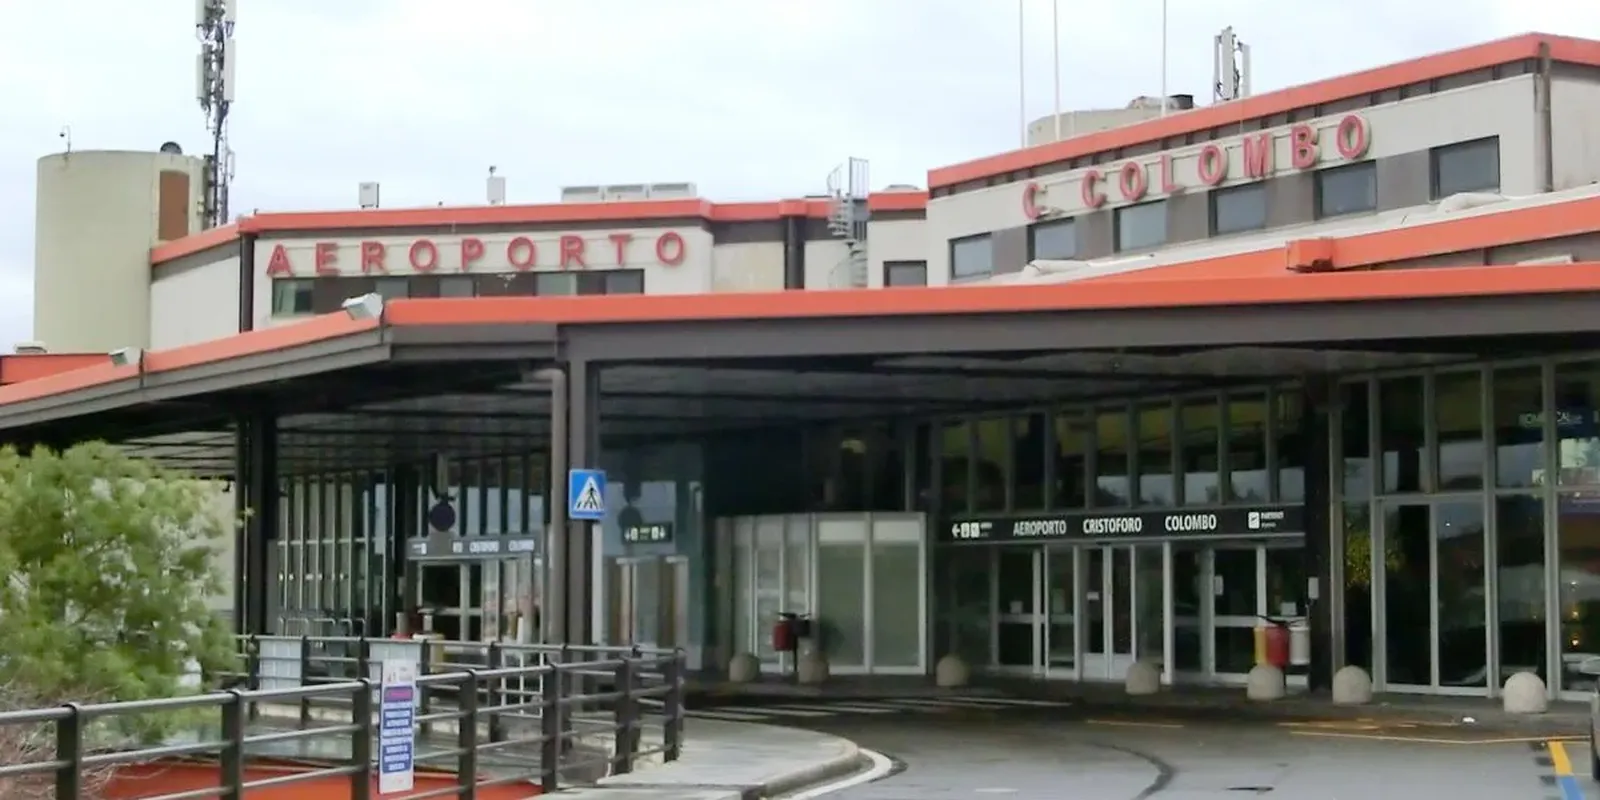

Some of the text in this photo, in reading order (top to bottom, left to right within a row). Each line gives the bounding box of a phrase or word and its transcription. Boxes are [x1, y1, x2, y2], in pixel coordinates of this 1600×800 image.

[1081, 114, 1370, 208] COLOMBO
[267, 230, 687, 277] AEROPORTO
[1012, 520, 1067, 537] AEROPORTO
[1082, 517, 1143, 534] CRISTOFORO
[1164, 513, 1217, 532] COLOMBO
